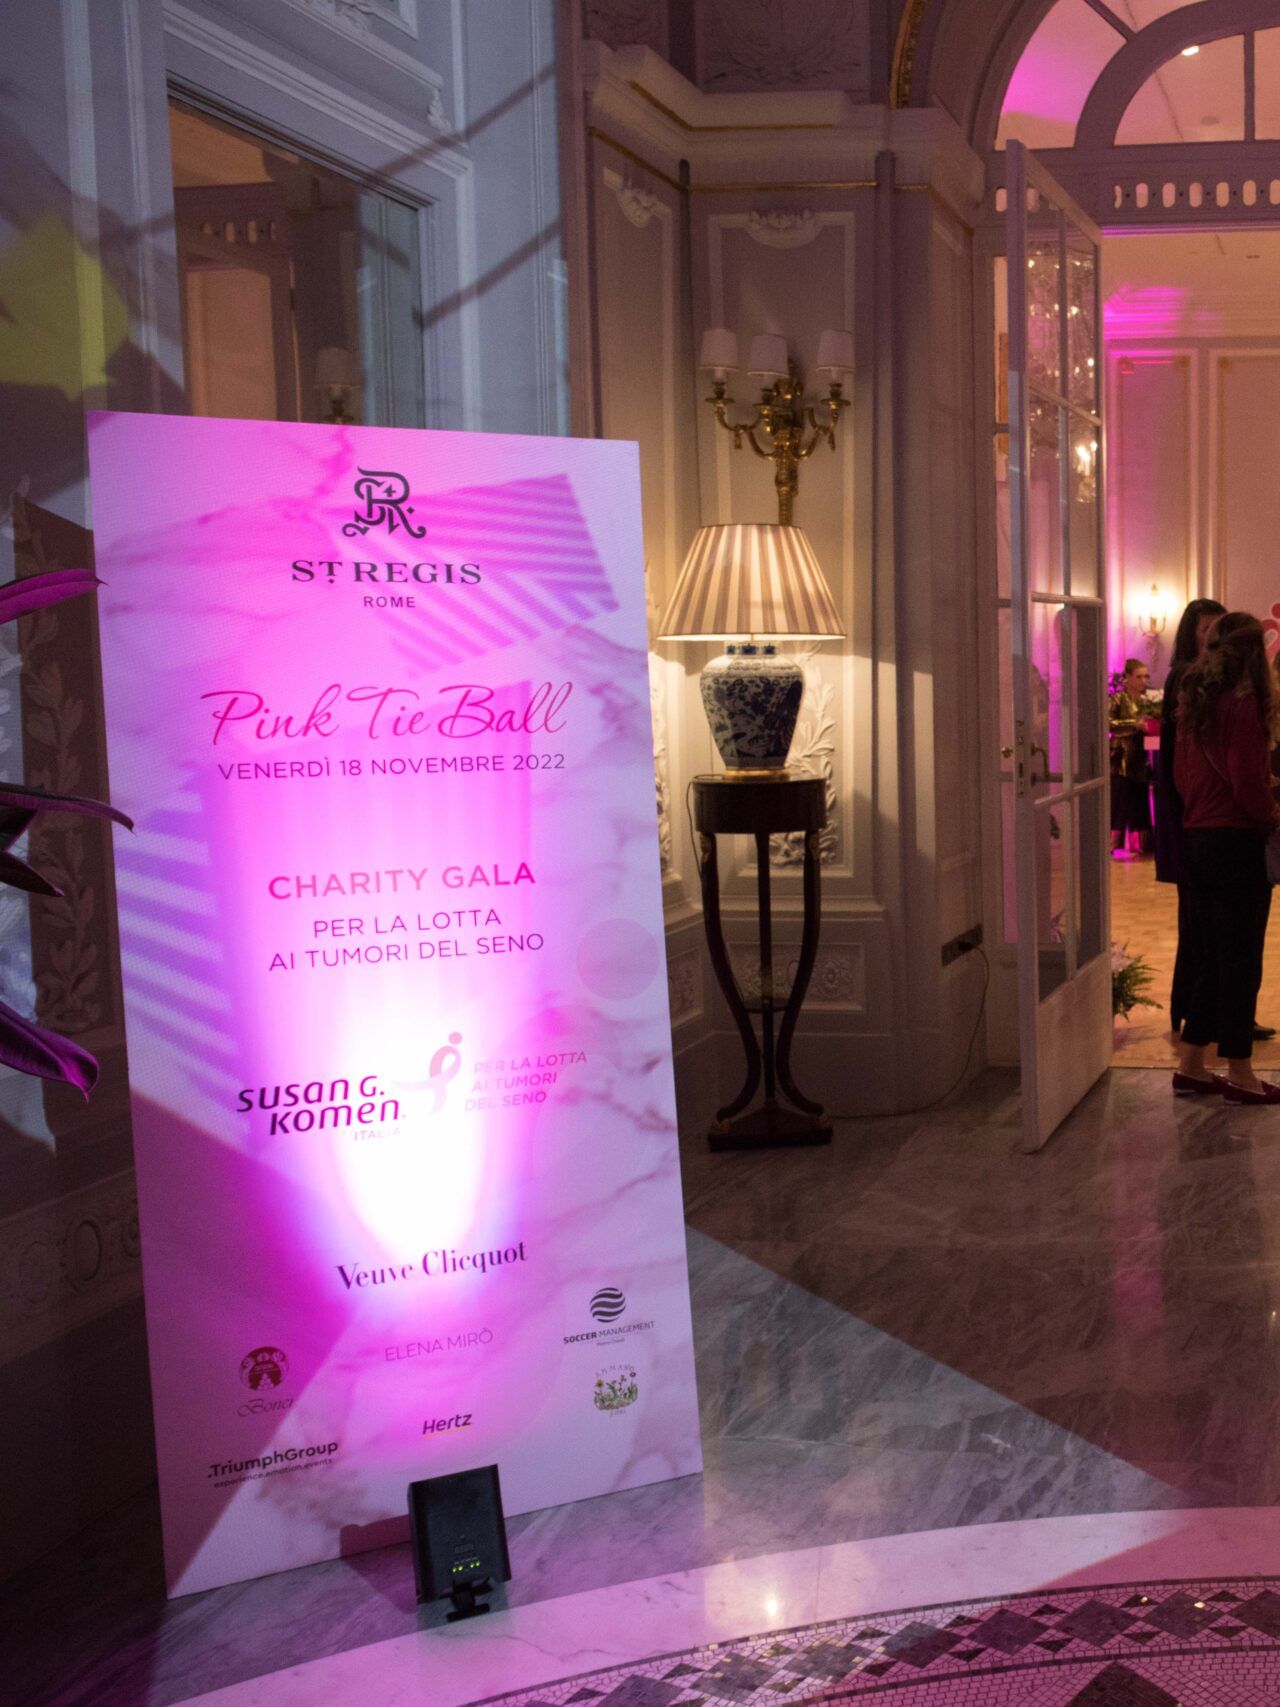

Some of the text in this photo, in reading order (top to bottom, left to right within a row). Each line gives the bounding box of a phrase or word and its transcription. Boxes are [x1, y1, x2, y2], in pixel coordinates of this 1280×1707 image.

[353, 561, 482, 585] REGIS
[362, 595, 416, 609] ROME
[200, 681, 573, 745] Pink Tie Ball
[217, 753, 566, 780] VENERDÌ 18 NOVEMBRE 2022
[268, 862, 536, 900] CHARITY GALA
[313, 908, 501, 938] PER LA LOTTA
[268, 933, 545, 971] AI TUMORI DEL SENO
[473, 1050, 588, 1074] PER LA LOTTA
[495, 1071, 558, 1090] TUMORI
[502, 1090, 547, 1107] SENO
[335, 1241, 529, 1291] Veuve Clicquot
[563, 1332, 597, 1345] SOCCER
[598, 1321, 655, 1338] MANAGEMENT
[385, 1341, 444, 1362] ELENA
[422, 1413, 473, 1435] Hertz
